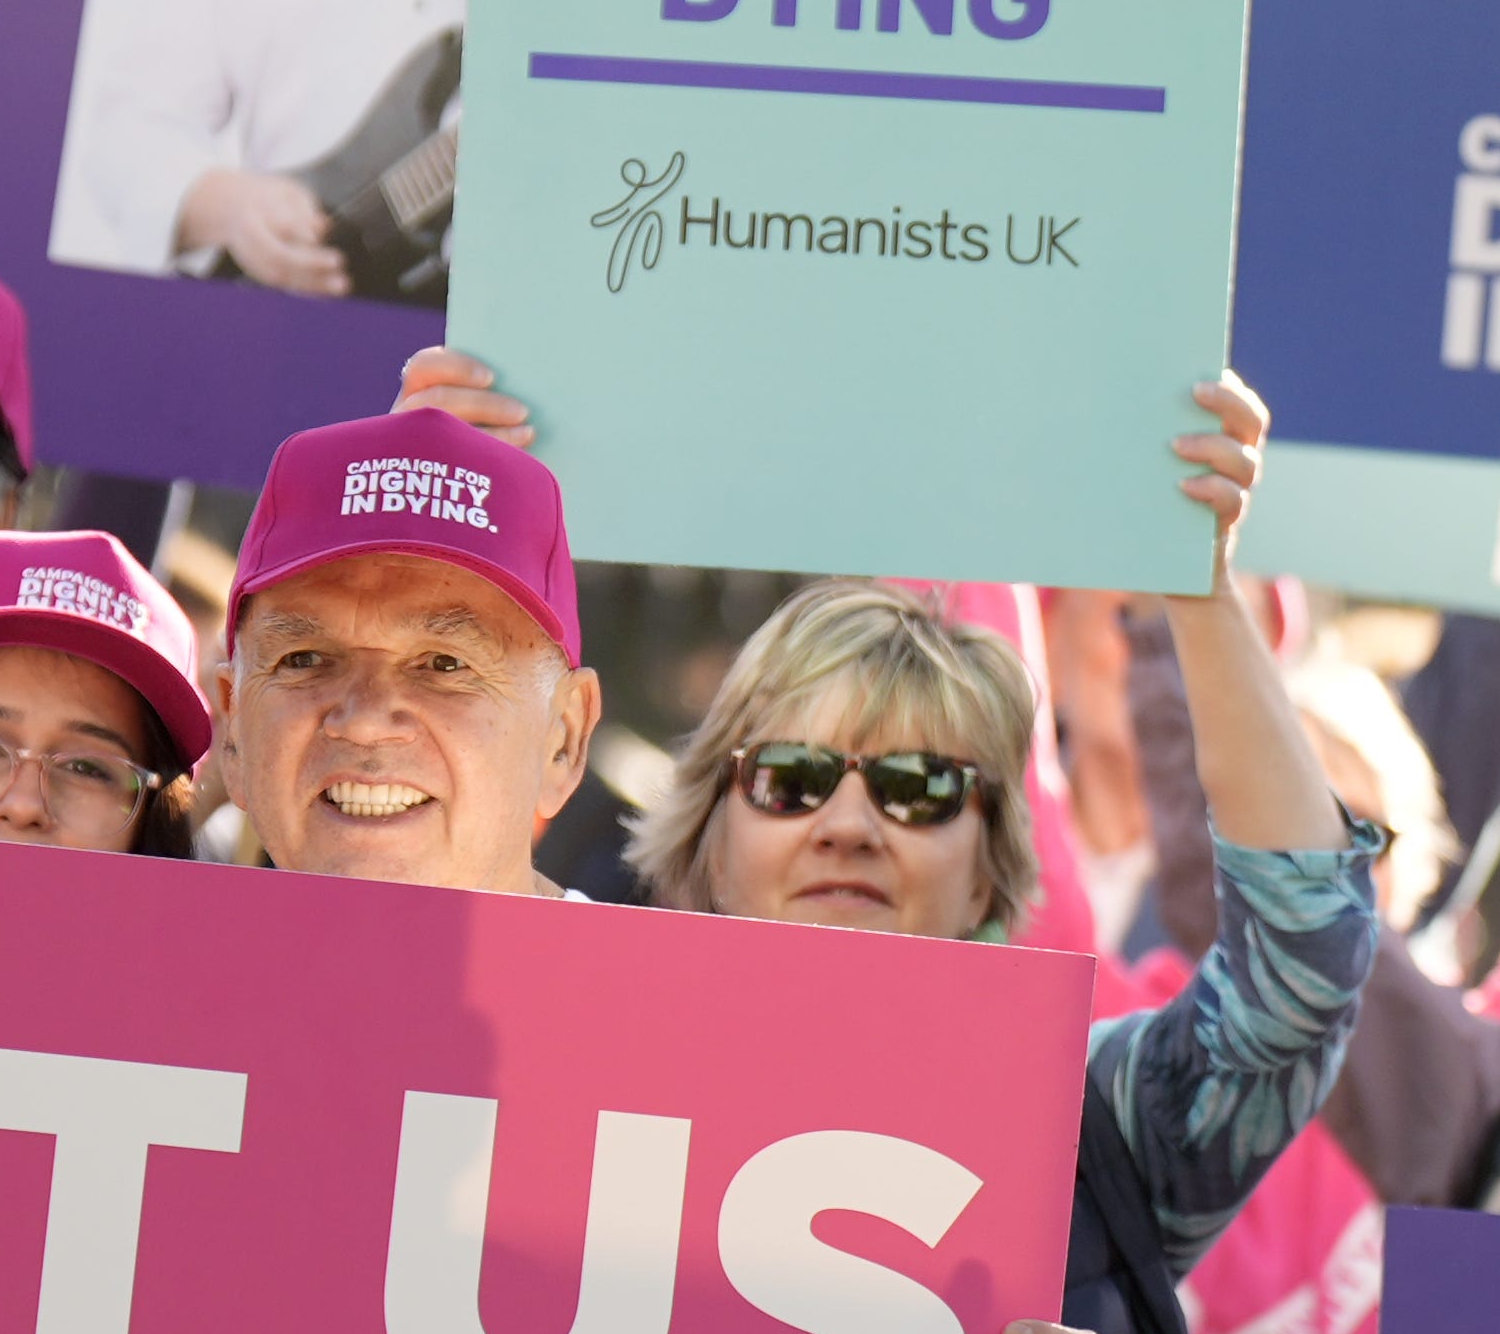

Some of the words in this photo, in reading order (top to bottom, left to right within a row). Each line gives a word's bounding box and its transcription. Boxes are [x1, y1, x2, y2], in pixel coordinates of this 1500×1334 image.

[677, 194, 990, 264] Humanists
[1003, 214, 1082, 269] UK
[343, 470, 491, 508] DIGNITY
[346, 457, 449, 478] CAMPAIGN
[453, 466, 492, 491] FOR
[340, 492, 377, 516] IN
[380, 493, 500, 534] DYING.
